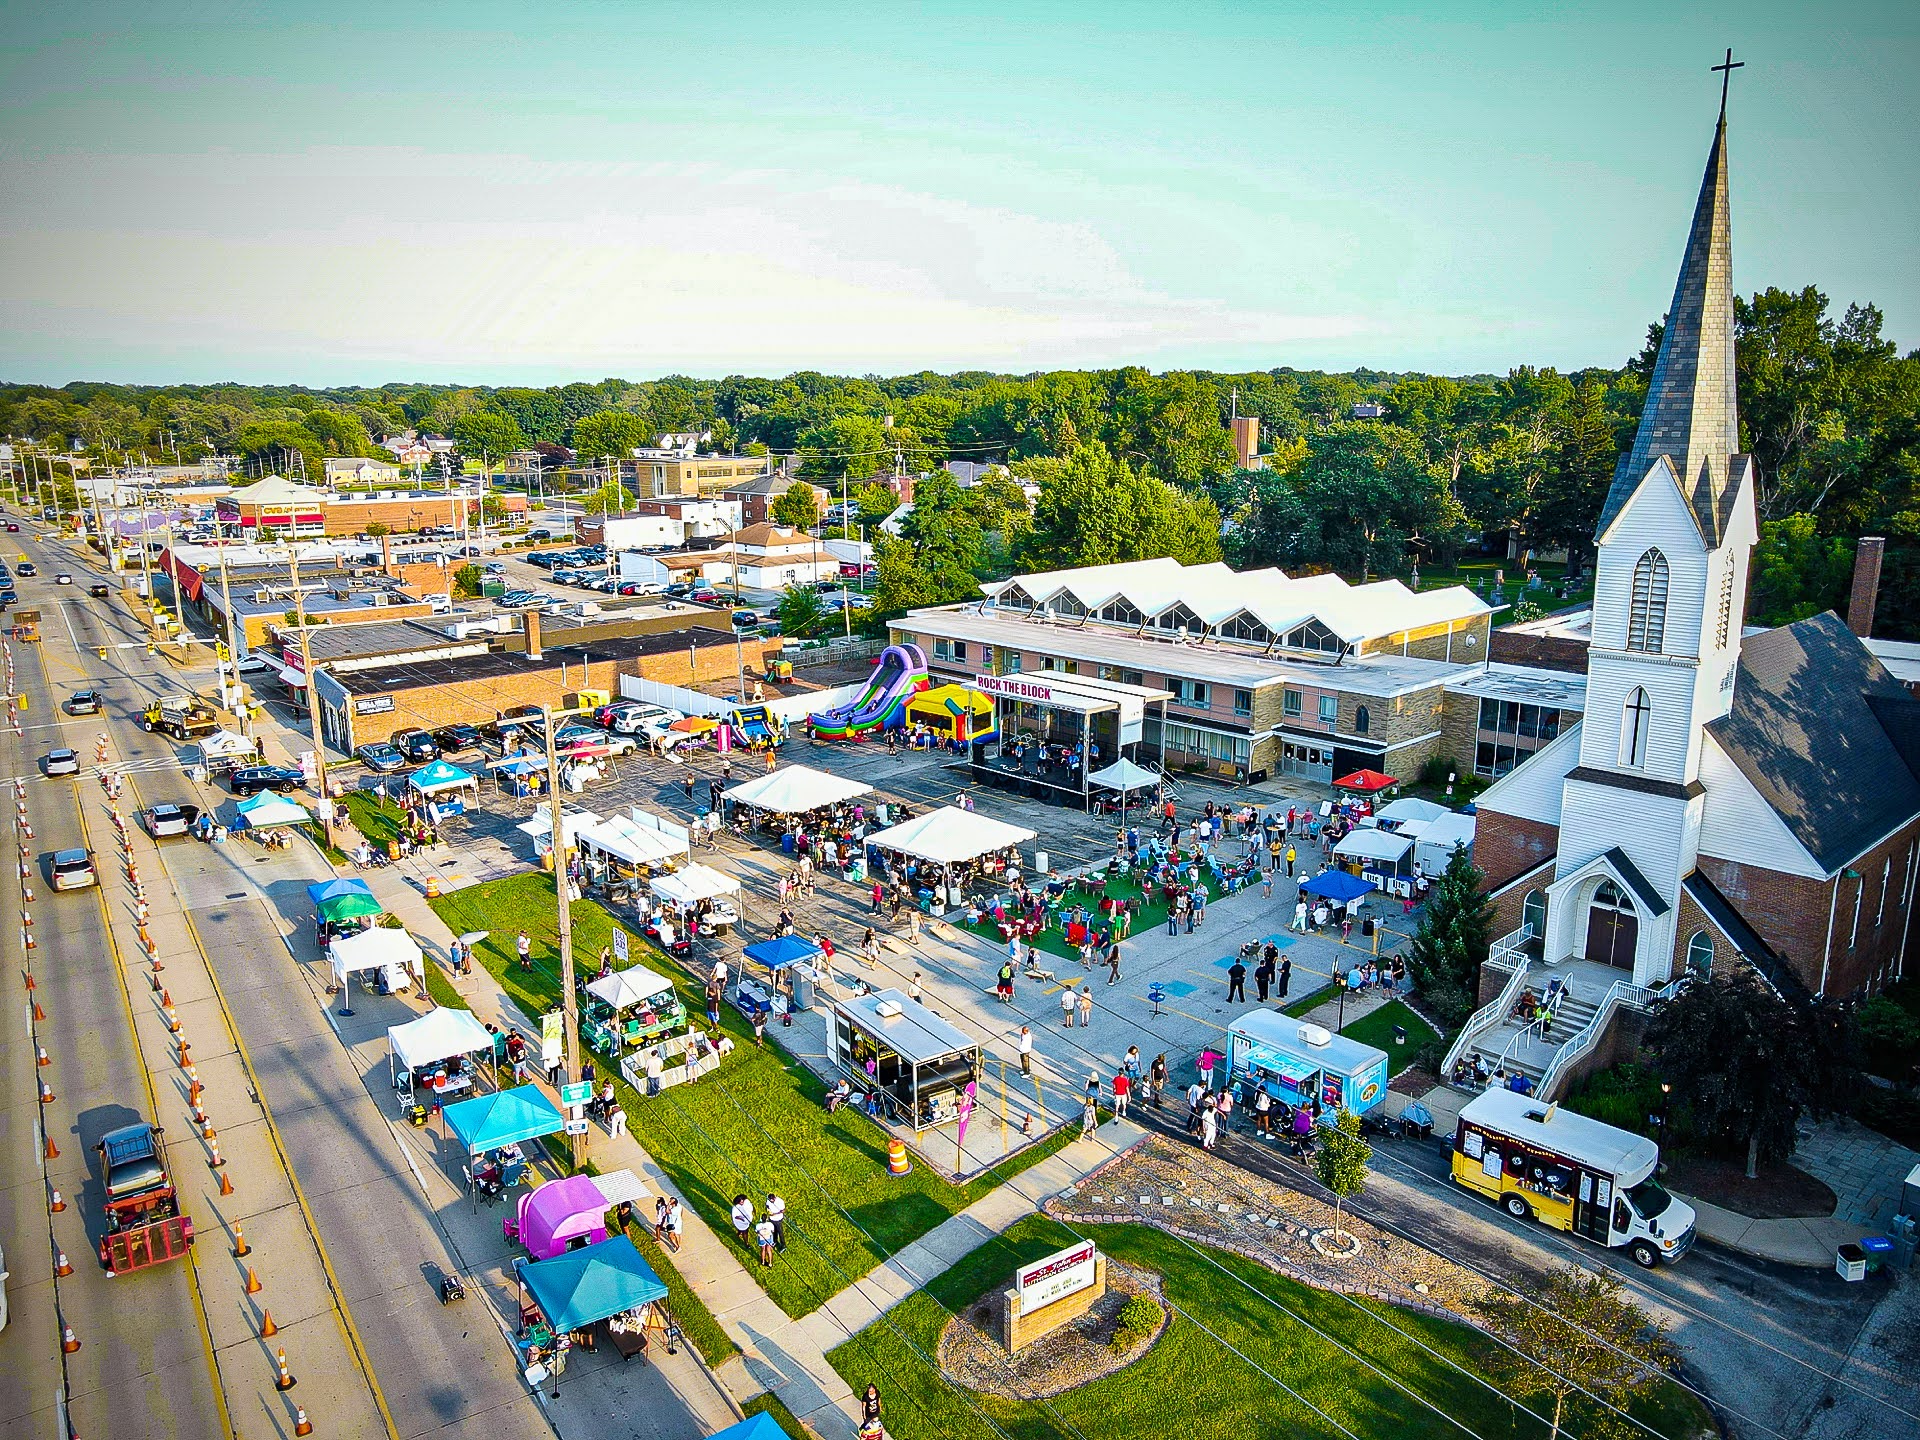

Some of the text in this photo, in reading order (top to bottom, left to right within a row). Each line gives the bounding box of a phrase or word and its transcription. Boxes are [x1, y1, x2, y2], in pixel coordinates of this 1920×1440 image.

[978, 676, 1051, 700] ROCK THE BLOCK
